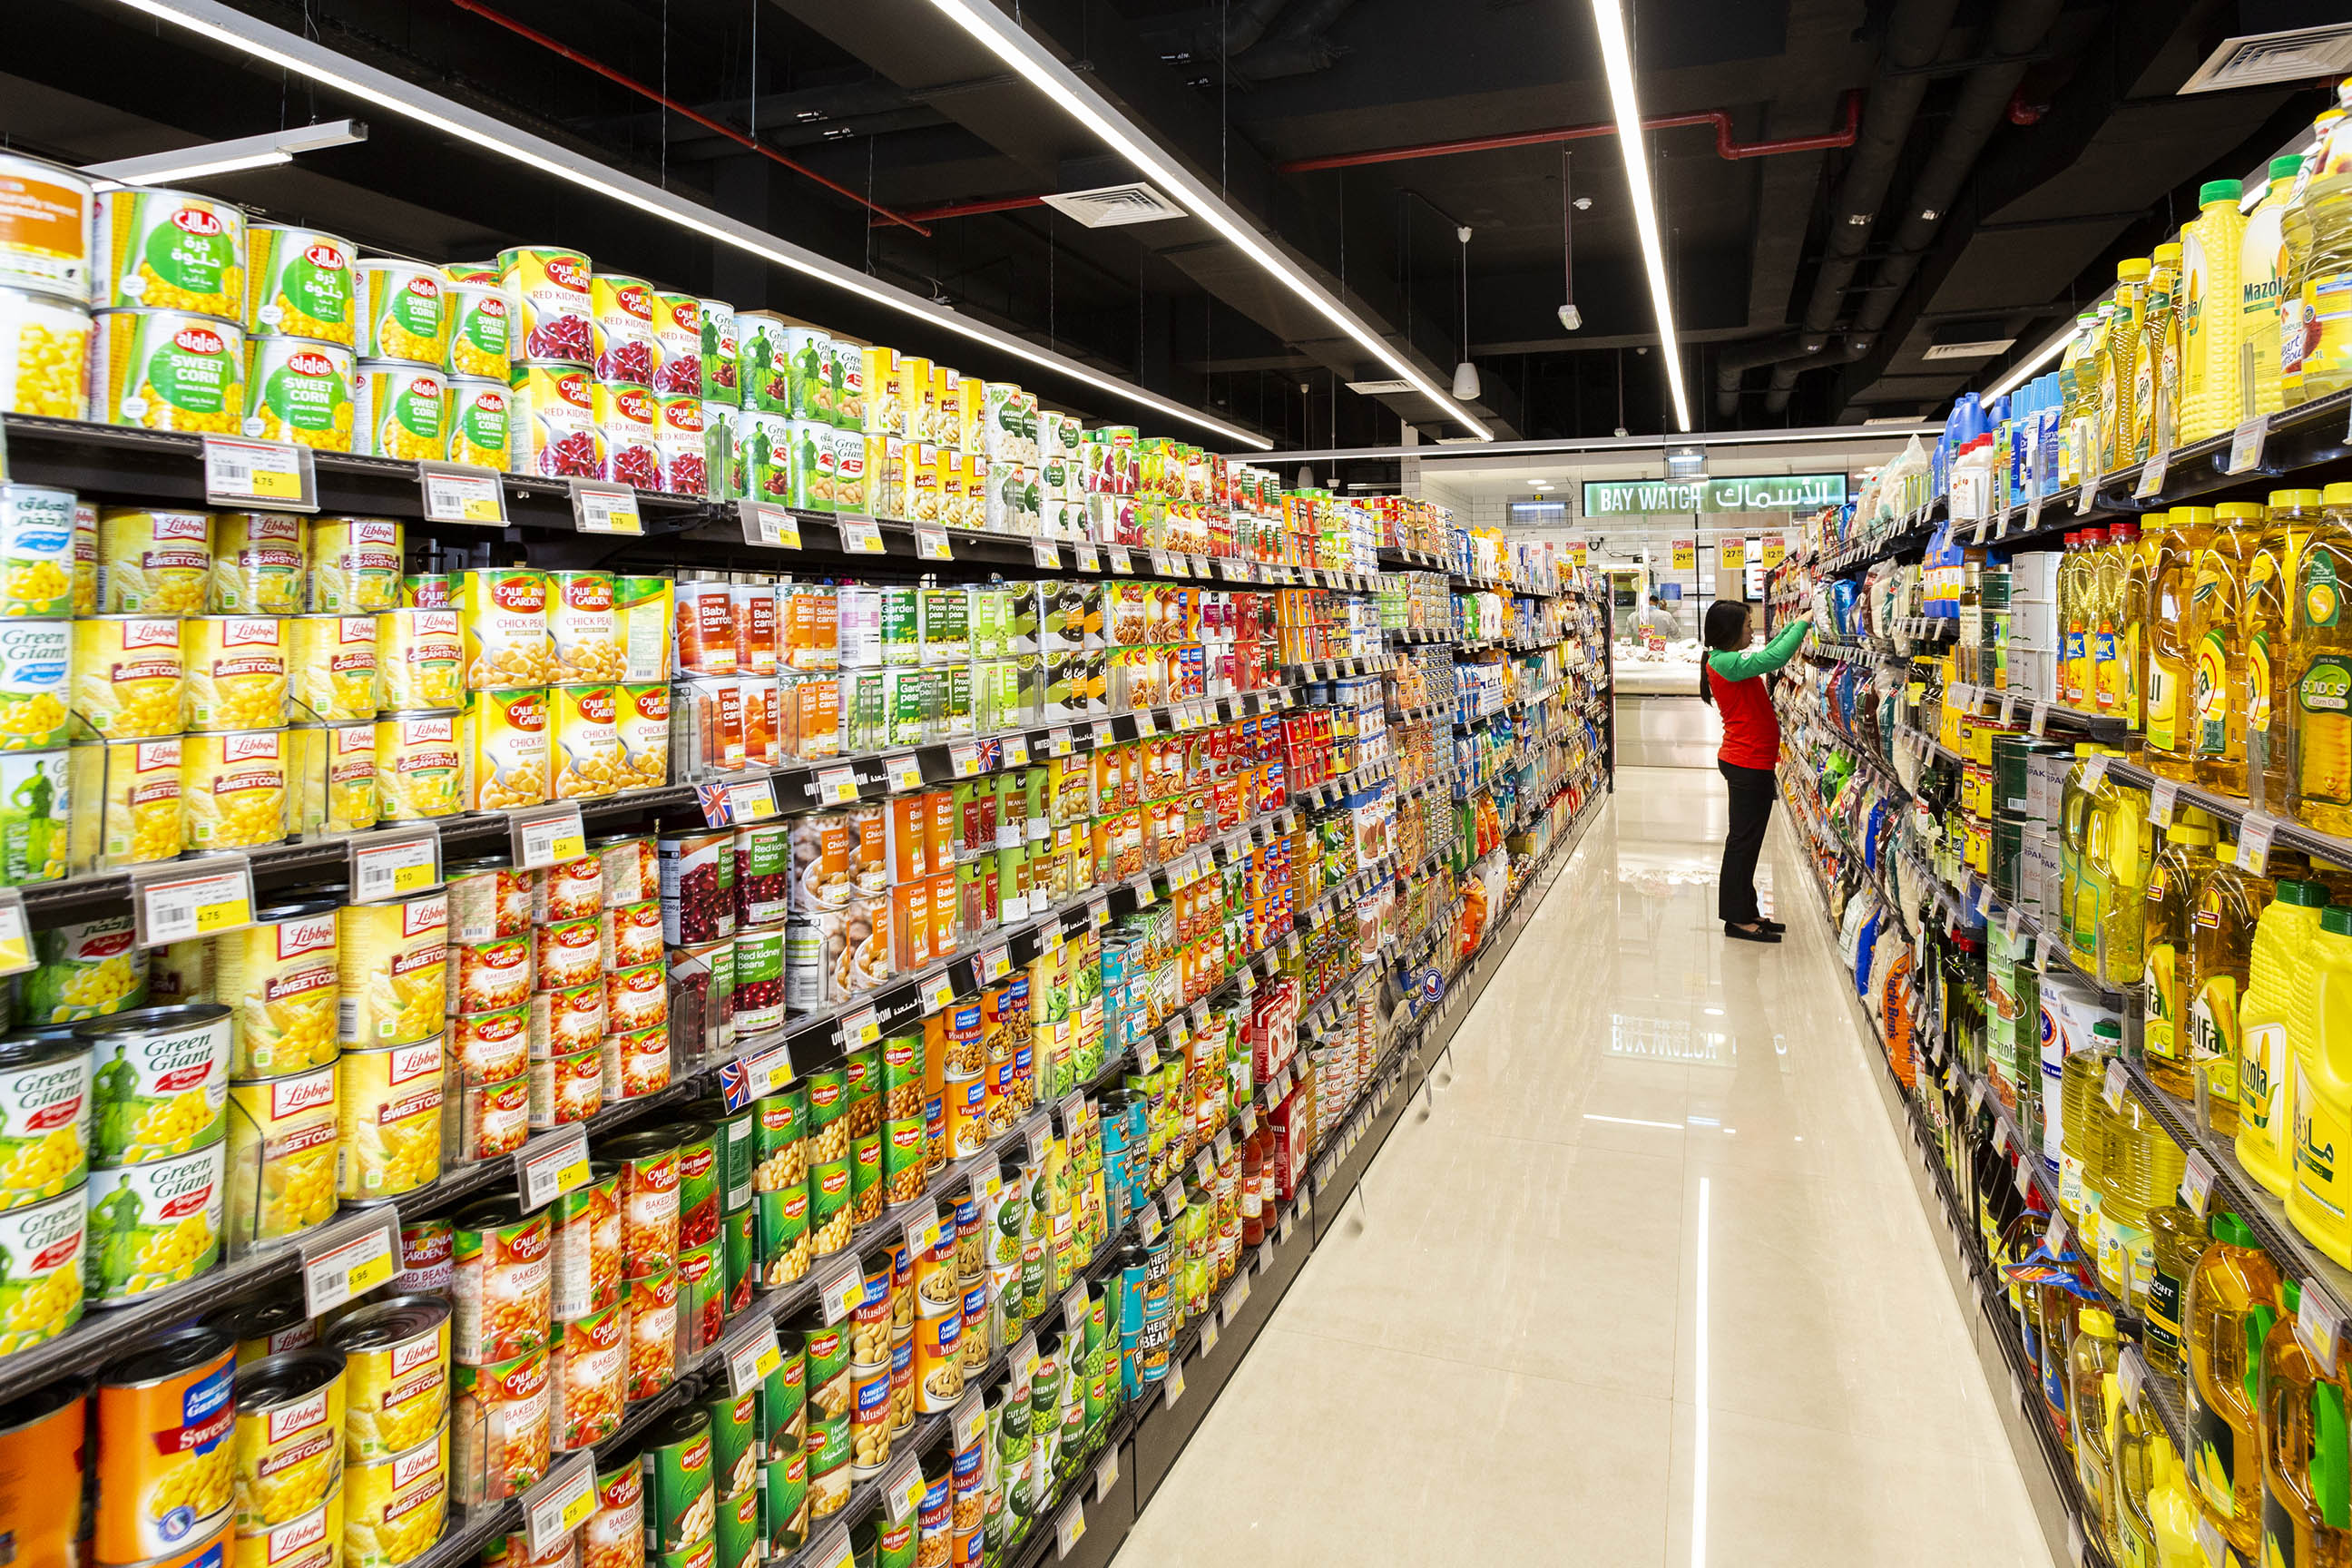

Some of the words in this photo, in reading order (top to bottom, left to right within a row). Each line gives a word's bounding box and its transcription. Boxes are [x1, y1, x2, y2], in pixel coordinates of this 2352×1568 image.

[533, 290, 553, 299] RED
[555, 291, 586, 302] KIDNEY
[2243, 279, 2283, 302] Mazol
[407, 297, 438, 309] SWEET
[410, 307, 436, 318] CORN
[477, 315, 505, 328] SWEET
[604, 317, 622, 325] RED
[481, 325, 504, 336] CORN
[661, 331, 676, 339] RED
[679, 332, 701, 343] KIDNE
[171, 356, 224, 372] SWEET
[176, 368, 220, 384] CORN
[283, 377, 334, 392] SWEET
[289, 390, 329, 403] CORN
[409, 397, 438, 410] SWEET
[413, 407, 436, 417] CORN
[475, 412, 505, 424] SWEET
[544, 407, 564, 416] RED
[566, 409, 591, 419] KIDNE
[478, 421, 502, 431] CORN
[1601, 486, 1635, 512] BAY
[1639, 486, 1701, 510] WATCH
[1716, 479, 1828, 508] الأسماك
[164, 517, 203, 533] Libby's
[260, 517, 296, 534] Libby's
[507, 595, 543, 607] GARDEN
[575, 595, 610, 605] GARDEN
[702, 606, 726, 617] Baby
[754, 610, 772, 619] Baby
[881, 603, 915, 615] Garden
[421, 614, 456, 629] Libby's
[496, 618, 526, 629] CHICK
[527, 618, 545, 628] PEA
[566, 616, 595, 626] CHICK
[881, 612, 905, 623] peas
[2, 630, 66, 644] Green
[136, 621, 177, 642] Libby's
[235, 621, 276, 640] Libby's
[7, 644, 66, 660] Giant
[2301, 680, 2347, 697] SONDOS
[2312, 697, 2328, 705] Corn
[2329, 698, 2339, 707] Oil
[414, 723, 449, 737] Libby's
[583, 730, 605, 740] CHICK
[638, 726, 660, 735] CHICK
[235, 736, 276, 755] Libby's
[510, 738, 534, 749] CHICK
[754, 843, 770, 855] Red
[771, 841, 788, 853] kidn
[754, 852, 779, 862] beans
[283, 924, 334, 949] Libby's
[738, 952, 755, 962] Red
[756, 947, 780, 962] kidney
[738, 960, 765, 970] beans
[957, 1018, 977, 1026] Garden
[948, 1031, 965, 1040] Foul
[144, 1034, 211, 1056] Green
[149, 1045, 214, 1071] Giant
[398, 1052, 441, 1074] Libby's
[13, 1064, 83, 1094] Green
[2242, 1056, 2267, 1099] azola
[18, 1080, 83, 1110] Giant
[286, 1078, 332, 1108] Libby's
[150, 1152, 211, 1186] Green
[153, 1170, 214, 1199] Giant
[645, 1195, 670, 1210] BAKED
[19, 1201, 82, 1237] Green
[23, 1218, 83, 1250] Giant
[1151, 1253, 1169, 1265] HEIN
[512, 1269, 540, 1284] BAKED
[1025, 1263, 1041, 1275] PEAS
[276, 1325, 316, 1353] Libby's
[1143, 1332, 1169, 1348] BEAN
[400, 1339, 438, 1368] Libby's
[861, 1380, 890, 1397] American
[861, 1392, 886, 1406] Garden
[278, 1400, 325, 1434] Libby's
[504, 1404, 536, 1422] BAKED
[1006, 1411, 1015, 1419] CUT
[180, 1412, 235, 1451] Sweet
[400, 1449, 436, 1477] Libby's
[955, 1461, 976, 1472] Garden
[1015, 1490, 1024, 1499] CUT
[609, 1510, 633, 1529] BAKED
[279, 1517, 325, 1553] Libby's
